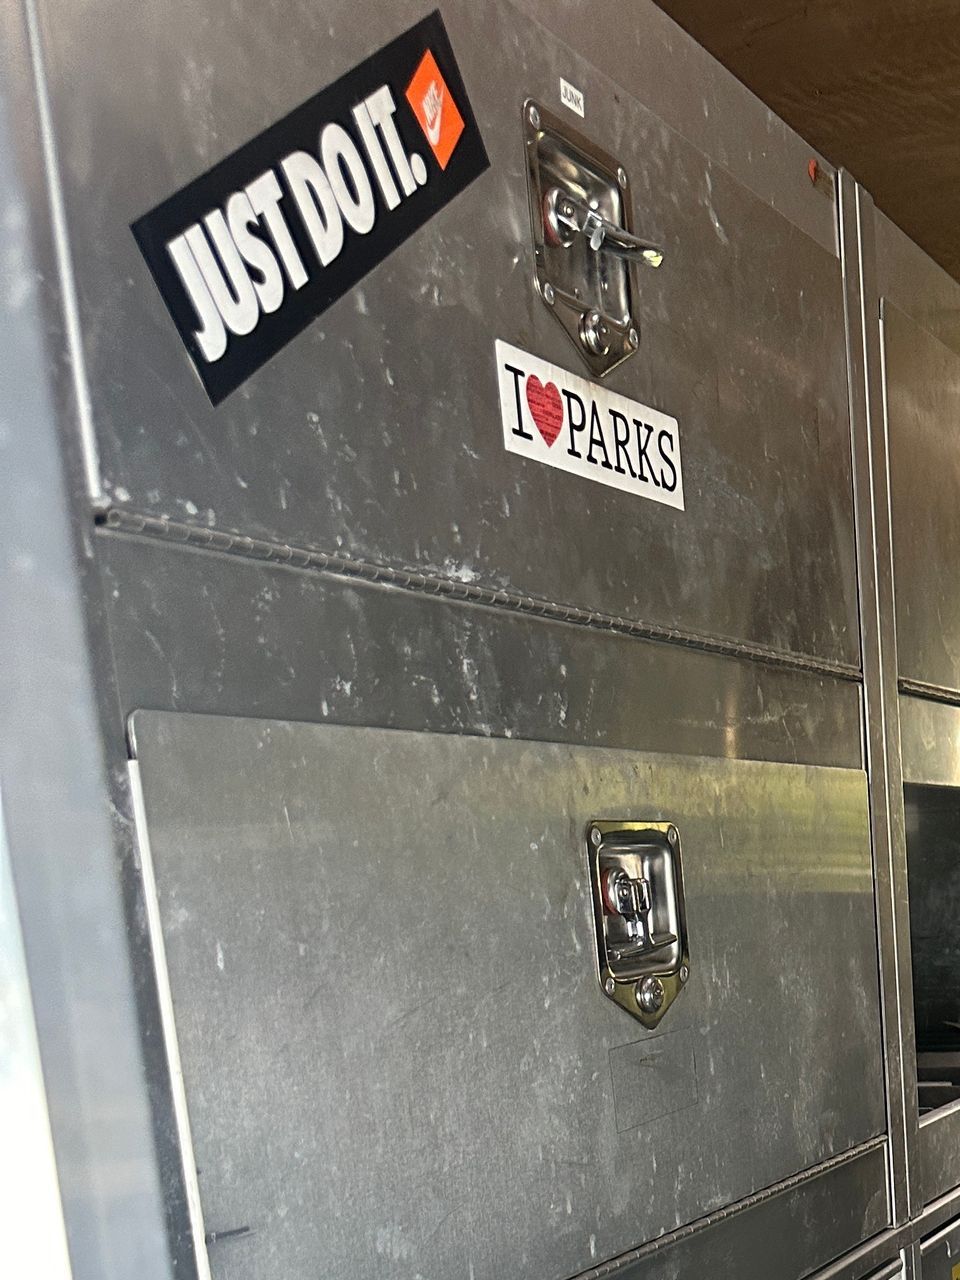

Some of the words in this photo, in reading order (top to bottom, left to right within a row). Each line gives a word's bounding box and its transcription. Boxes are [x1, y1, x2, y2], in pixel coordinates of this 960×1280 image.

[562, 85, 583, 111] JUNK
[166, 169, 309, 363] JUST
[281, 122, 376, 268] DO
[352, 84, 428, 212] IT.
[505, 363, 534, 441] I
[561, 388, 678, 492] PARKS
